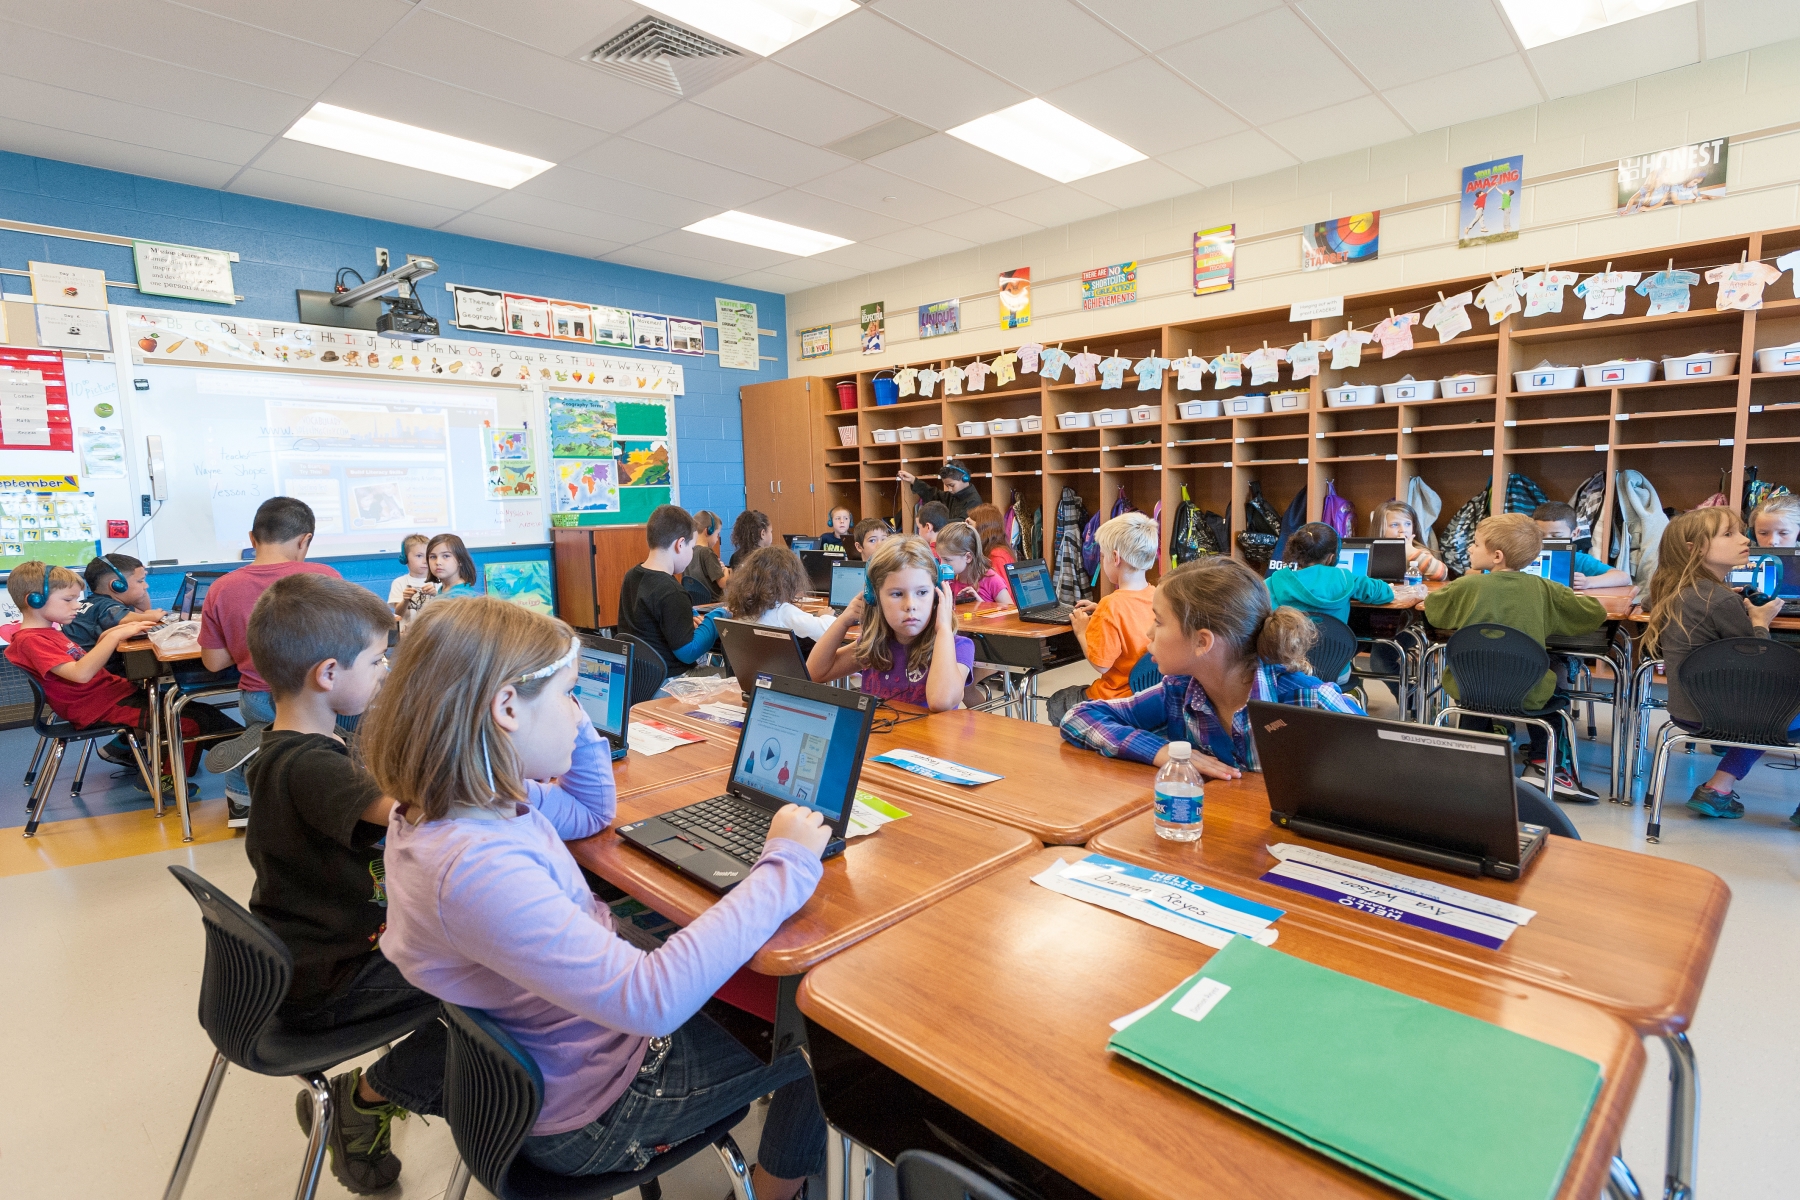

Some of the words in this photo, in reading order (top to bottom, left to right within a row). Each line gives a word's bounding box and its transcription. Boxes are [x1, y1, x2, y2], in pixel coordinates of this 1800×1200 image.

[1642, 140, 1724, 179] HONEST
[1474, 168, 1490, 180] YOU
[1491, 163, 1511, 175] ARE
[1465, 170, 1519, 193] AMAZING
[1310, 250, 1348, 267] TARGET
[1083, 270, 1098, 280] THERE
[1098, 268, 1107, 277] ARE
[1108, 266, 1120, 276] NO
[1092, 274, 1126, 290] SHORTCUTS
[1096, 282, 1136, 296] GREATEST
[469, 298, 494, 306] Themes
[928, 304, 938, 313] YOU
[1083, 292, 1135, 310] ACHIEVEMENTS
[462, 312, 498, 322] Geography
[636, 318, 662, 326] Movement
[922, 308, 956, 324] UNIQUE
[220, 322, 237, 335] Dd
[273, 327, 286, 339] Ff
[294, 329, 312, 345] Gg
[320, 332, 336, 344] Hh
[344, 334, 356, 346] Ii
[366, 336, 377, 351] Jj
[390, 339, 402, 350] Kk
[427, 342, 444, 354] Mm
[448, 344, 461, 356] Nn
[468, 346, 482, 357] Oo
[490, 348, 501, 362] Pp
[539, 352, 548, 362] Rr
[556, 354, 564, 364] Ss
[572, 356, 580, 366] Tt
[586, 358, 596, 368] Uu
[602, 359, 613, 368] Vv
[618, 361, 630, 370] Ww
[636, 362, 645, 372] Xx
[652, 364, 661, 375] Yy
[668, 366, 676, 376] Zz
[194, 461, 223, 479] Wayne
[0, 479, 62, 488] eptember
[250, 483, 260, 497] 3
[42, 504, 50, 512] 4
[27, 530, 38, 539] 17
[8, 544, 21, 552] 23
[1152, 872, 1205, 892] HELLO
[1094, 874, 1153, 894] Damian
[1162, 892, 1208, 917] Reyes
[1340, 880, 1398, 904] Watson
[1338, 898, 1403, 920] HELLO
[1358, 899, 1388, 911] NAME
[1415, 901, 1454, 918] Ava
